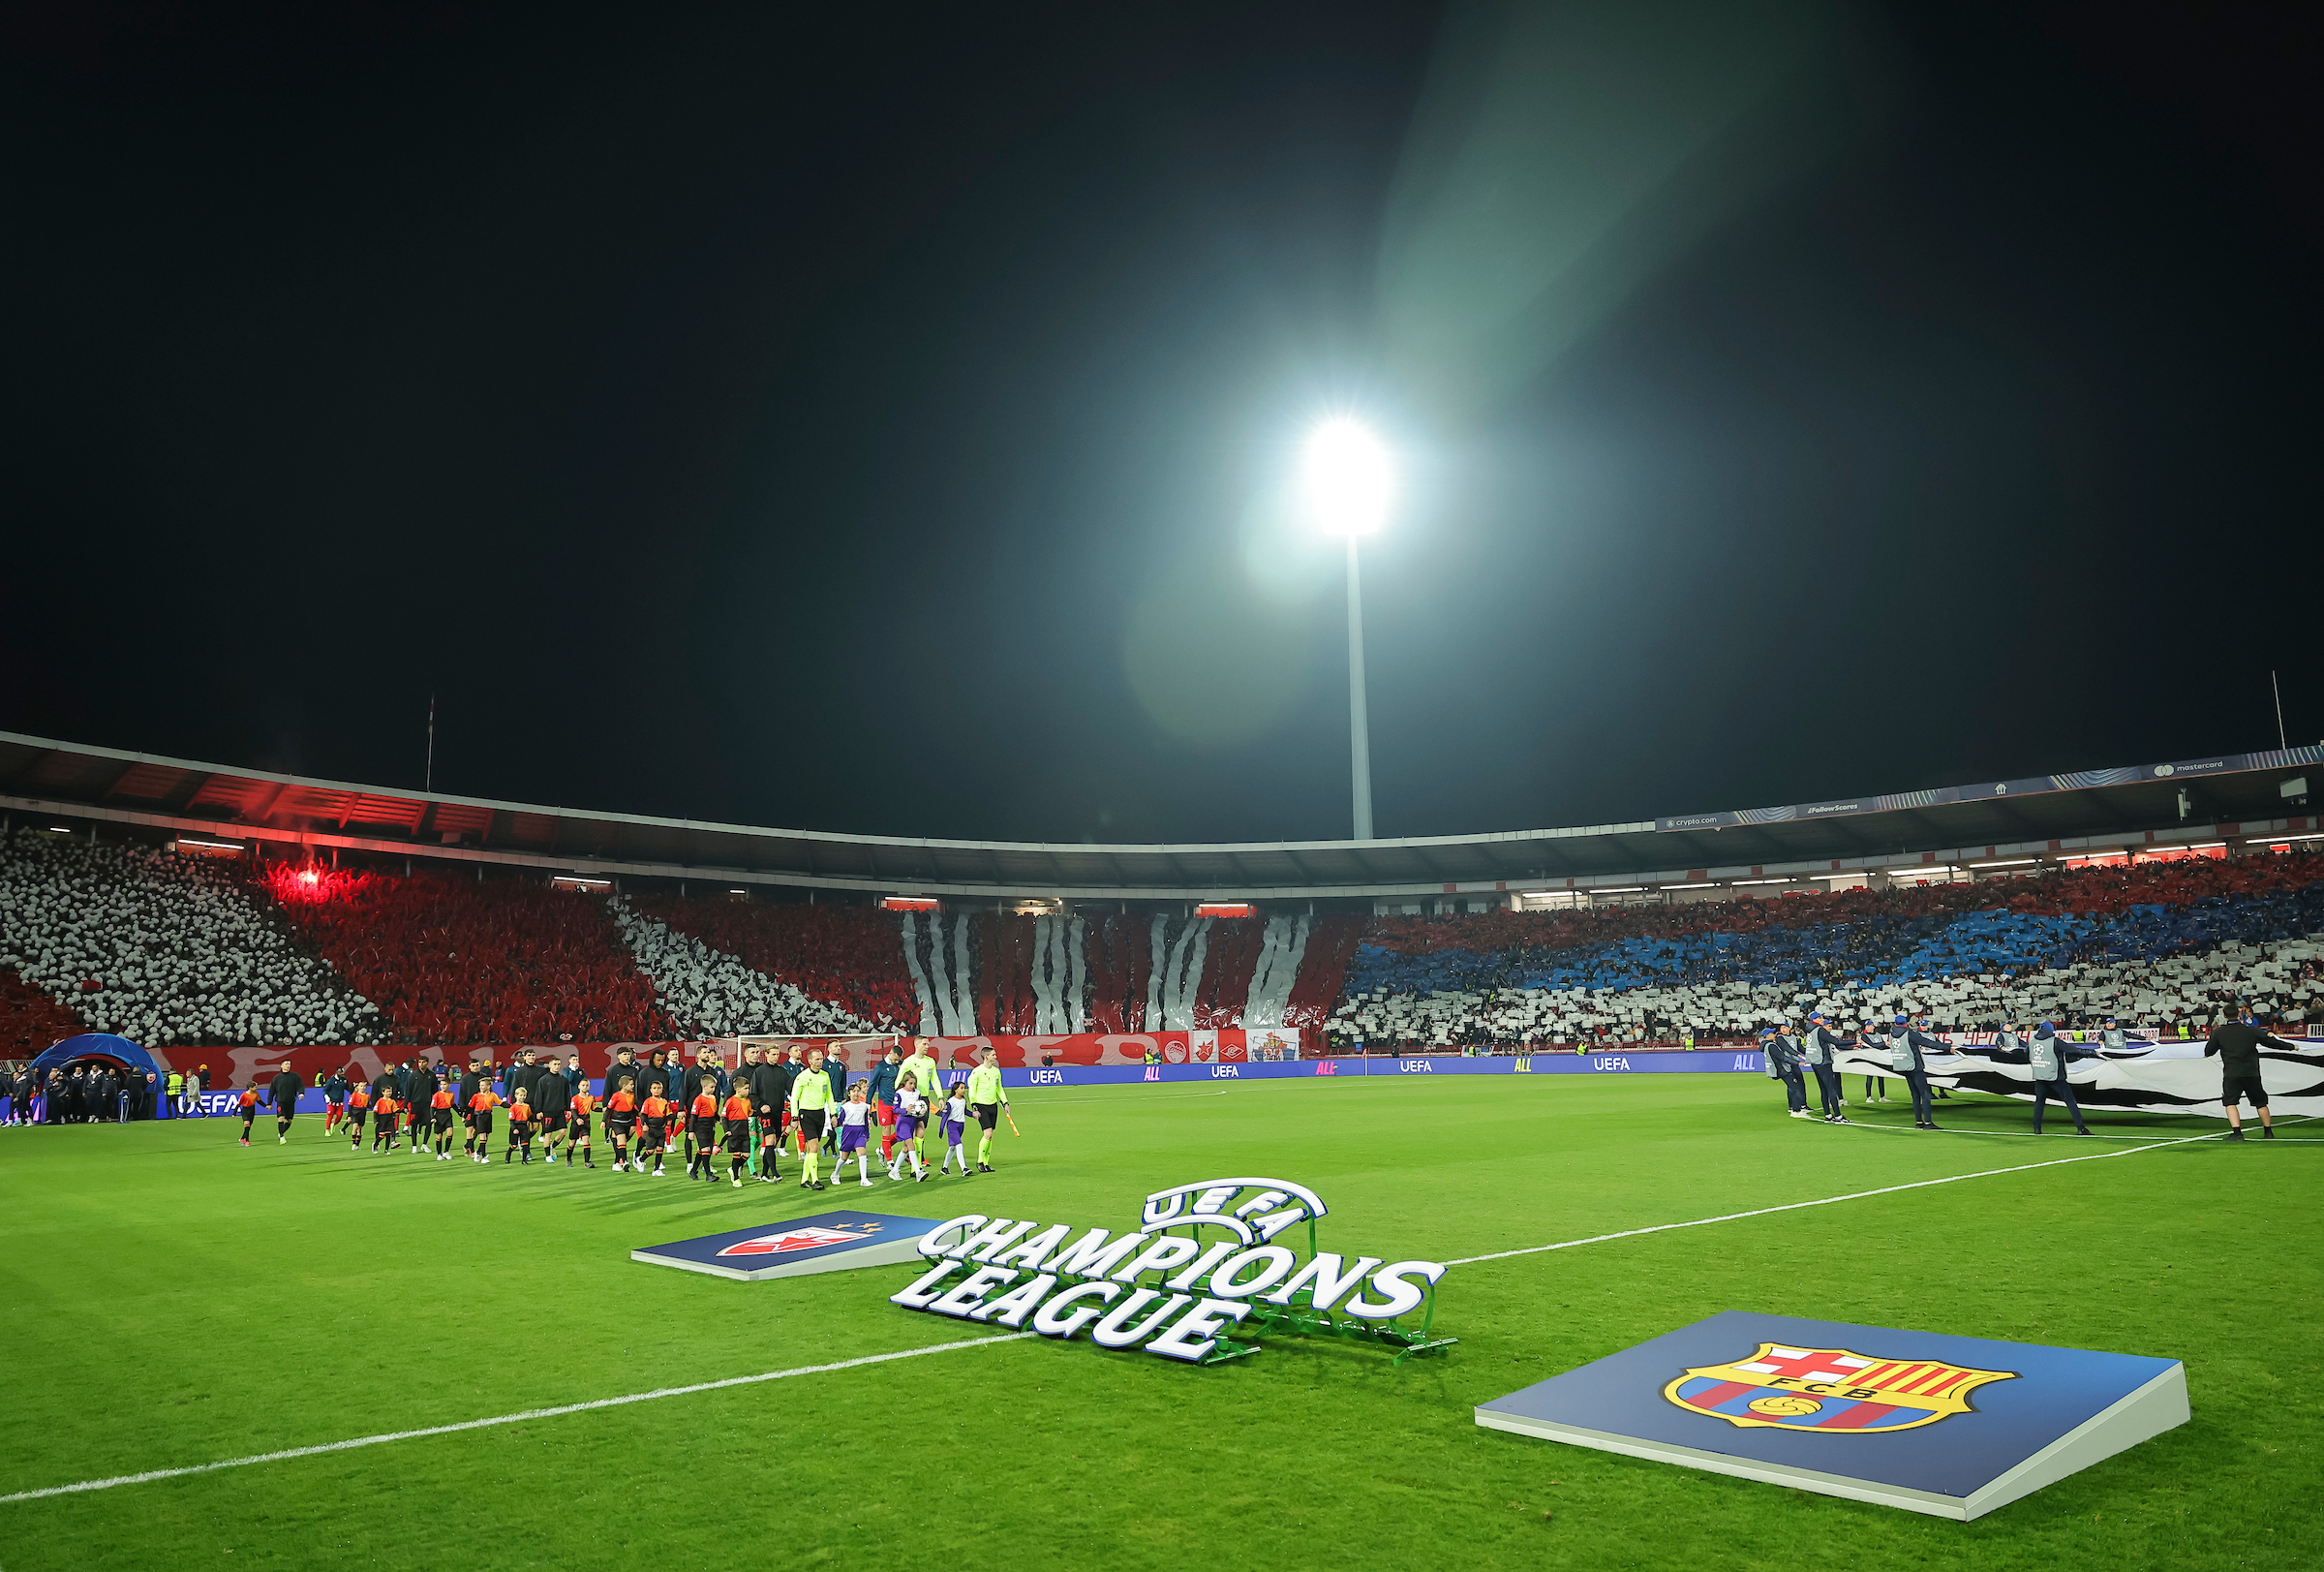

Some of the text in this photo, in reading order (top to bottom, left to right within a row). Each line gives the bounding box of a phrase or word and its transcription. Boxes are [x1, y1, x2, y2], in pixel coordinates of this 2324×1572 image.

[2177, 760, 2223, 772] mastercard
[1676, 817, 1717, 827] crypto.com
[1315, 1061, 1335, 1075] ALL
[1400, 1060, 1432, 1073] UEFA
[1514, 1058, 1532, 1072] ALL
[1594, 1058, 1631, 1071] UEFA
[1733, 1054, 1756, 1070] ALL
[1029, 1069, 1063, 1084] UEFA
[1144, 1066, 1160, 1081] ALL
[1211, 1065, 1239, 1078] UEFA
[177, 1094, 242, 1114] UEFA
[544, 1117, 553, 1125] 17
[762, 1118, 772, 1128] 21
[1141, 1187, 1309, 1244] UEFA
[916, 1213, 1450, 1320] CHAMPIONS
[889, 1258, 1255, 1362] LEAGUE
[1766, 1376, 1879, 1400] FCB
